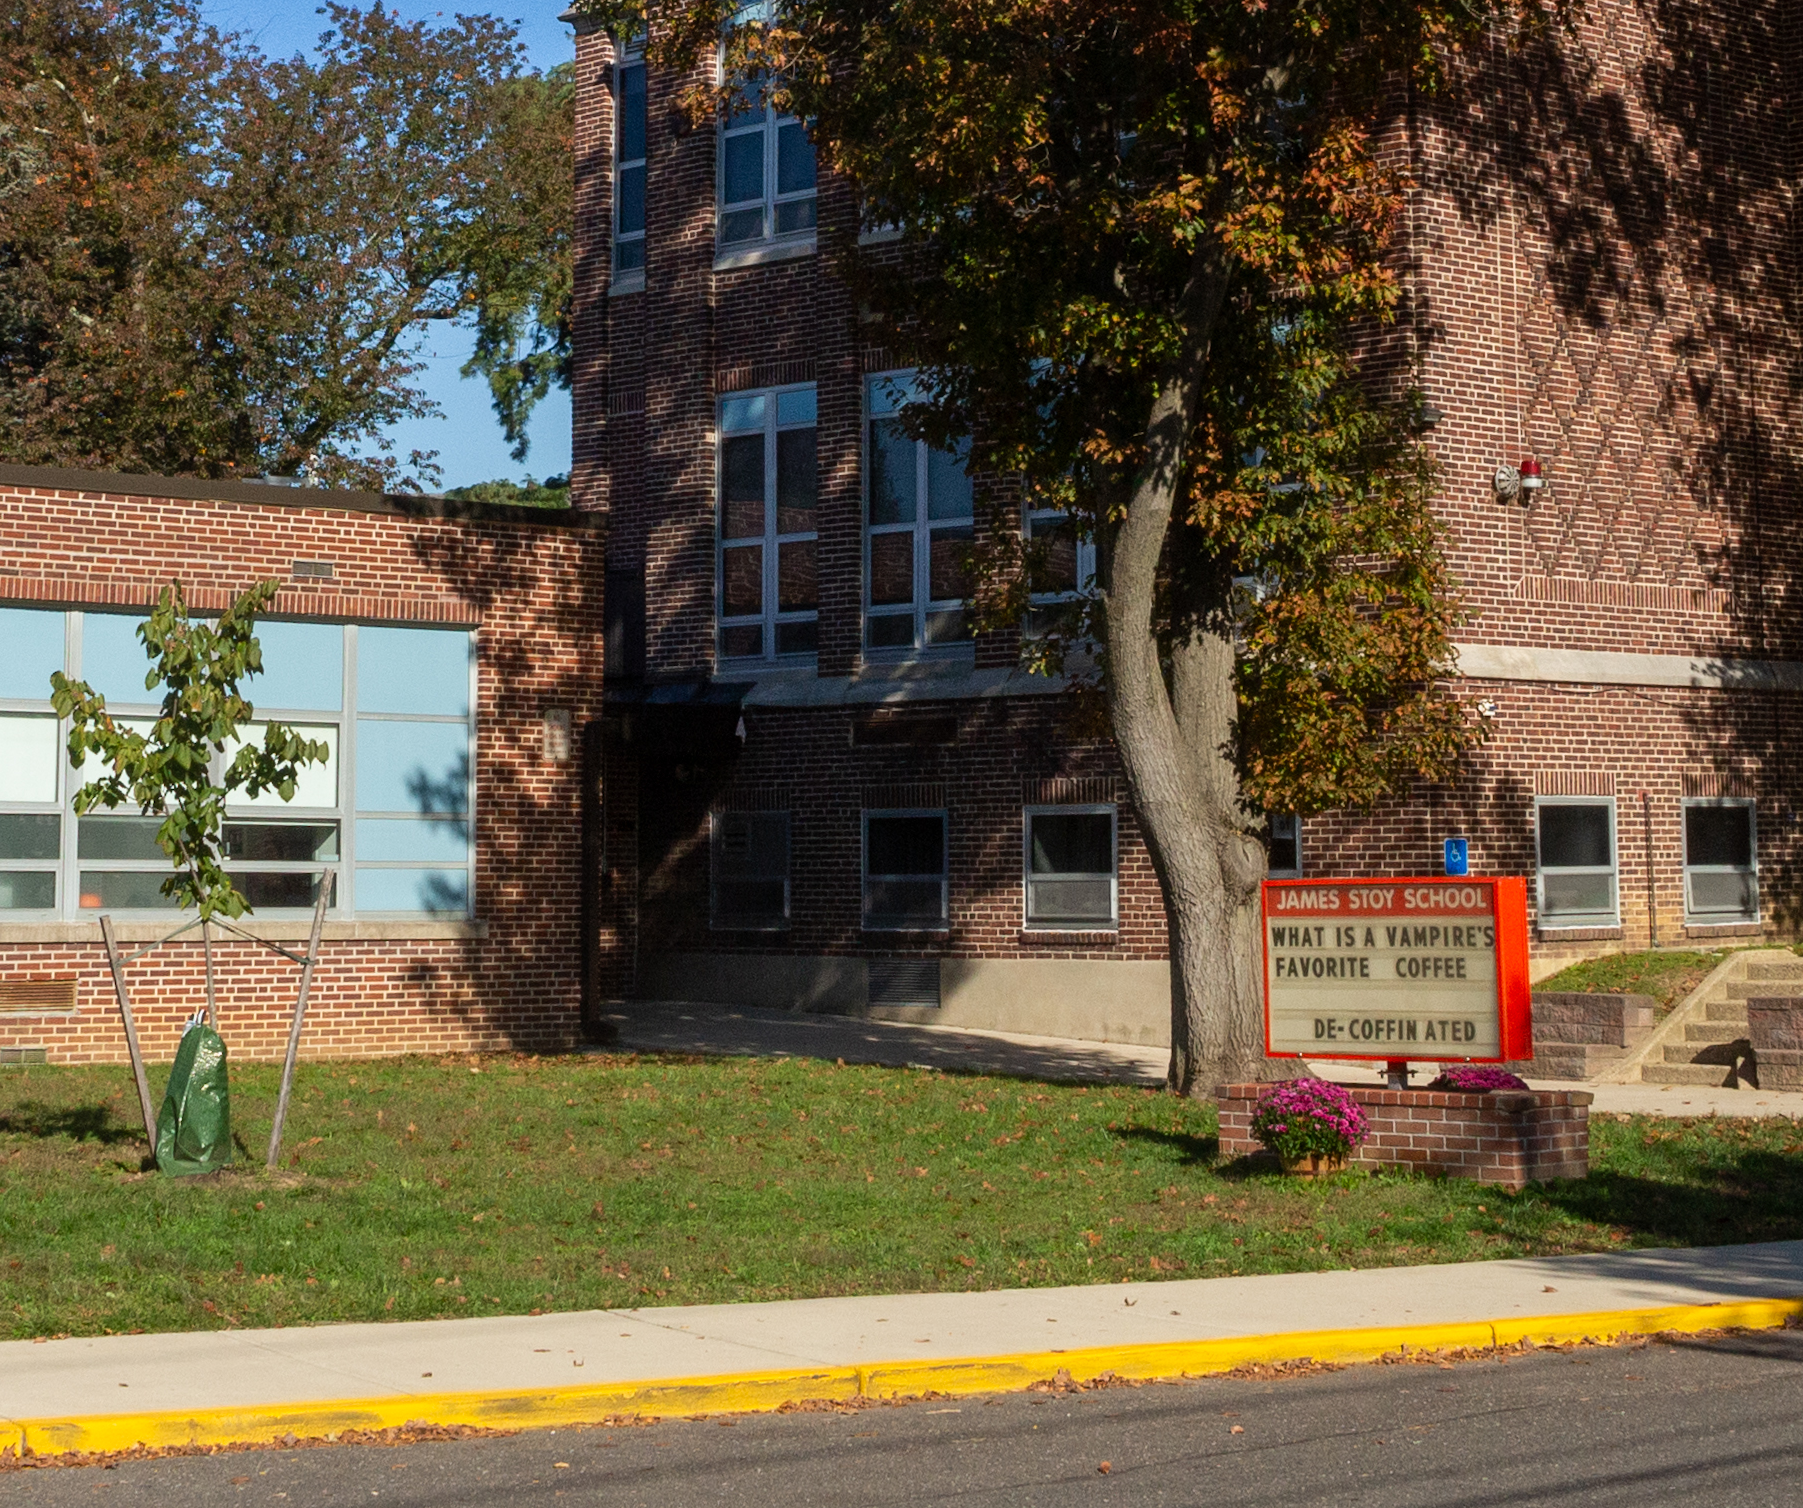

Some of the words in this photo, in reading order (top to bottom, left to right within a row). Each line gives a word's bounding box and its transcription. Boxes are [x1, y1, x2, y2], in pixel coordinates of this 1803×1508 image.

[1276, 888, 1340, 910] JAMES
[1348, 888, 1395, 910] STOY
[1403, 887, 1487, 909] SCHOOL
[1271, 926, 1325, 948] WHAT
[1336, 926, 1356, 948] IS
[1363, 926, 1376, 948] A
[1385, 925, 1495, 948] VAMPIRE'S
[1275, 956, 1370, 979] FAVORITE
[1395, 956, 1467, 979] COFFEE
